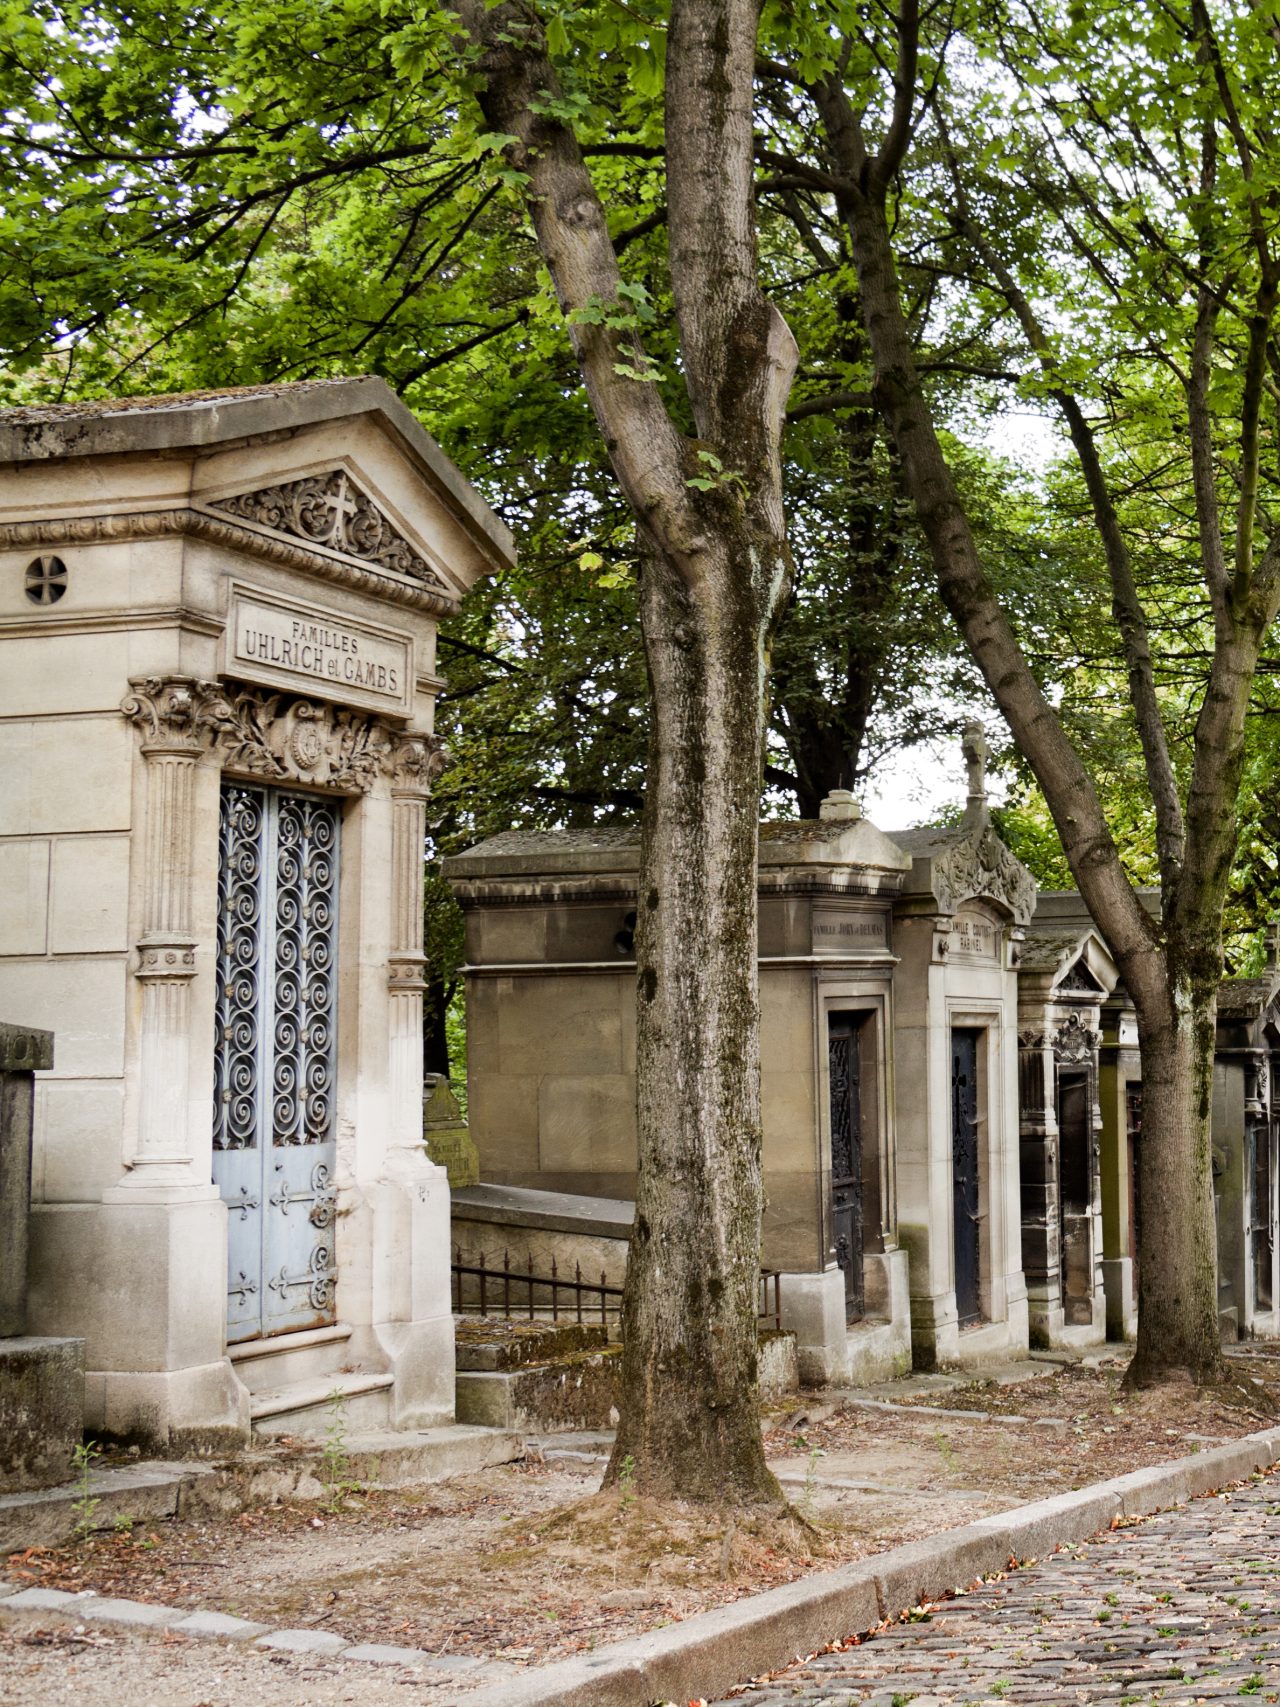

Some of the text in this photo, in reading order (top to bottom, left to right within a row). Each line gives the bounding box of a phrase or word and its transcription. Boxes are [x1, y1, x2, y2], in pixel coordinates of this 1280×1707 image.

[245, 630, 397, 691] UHLRICH et GAMBS
[292, 621, 358, 654] FAMILLES
